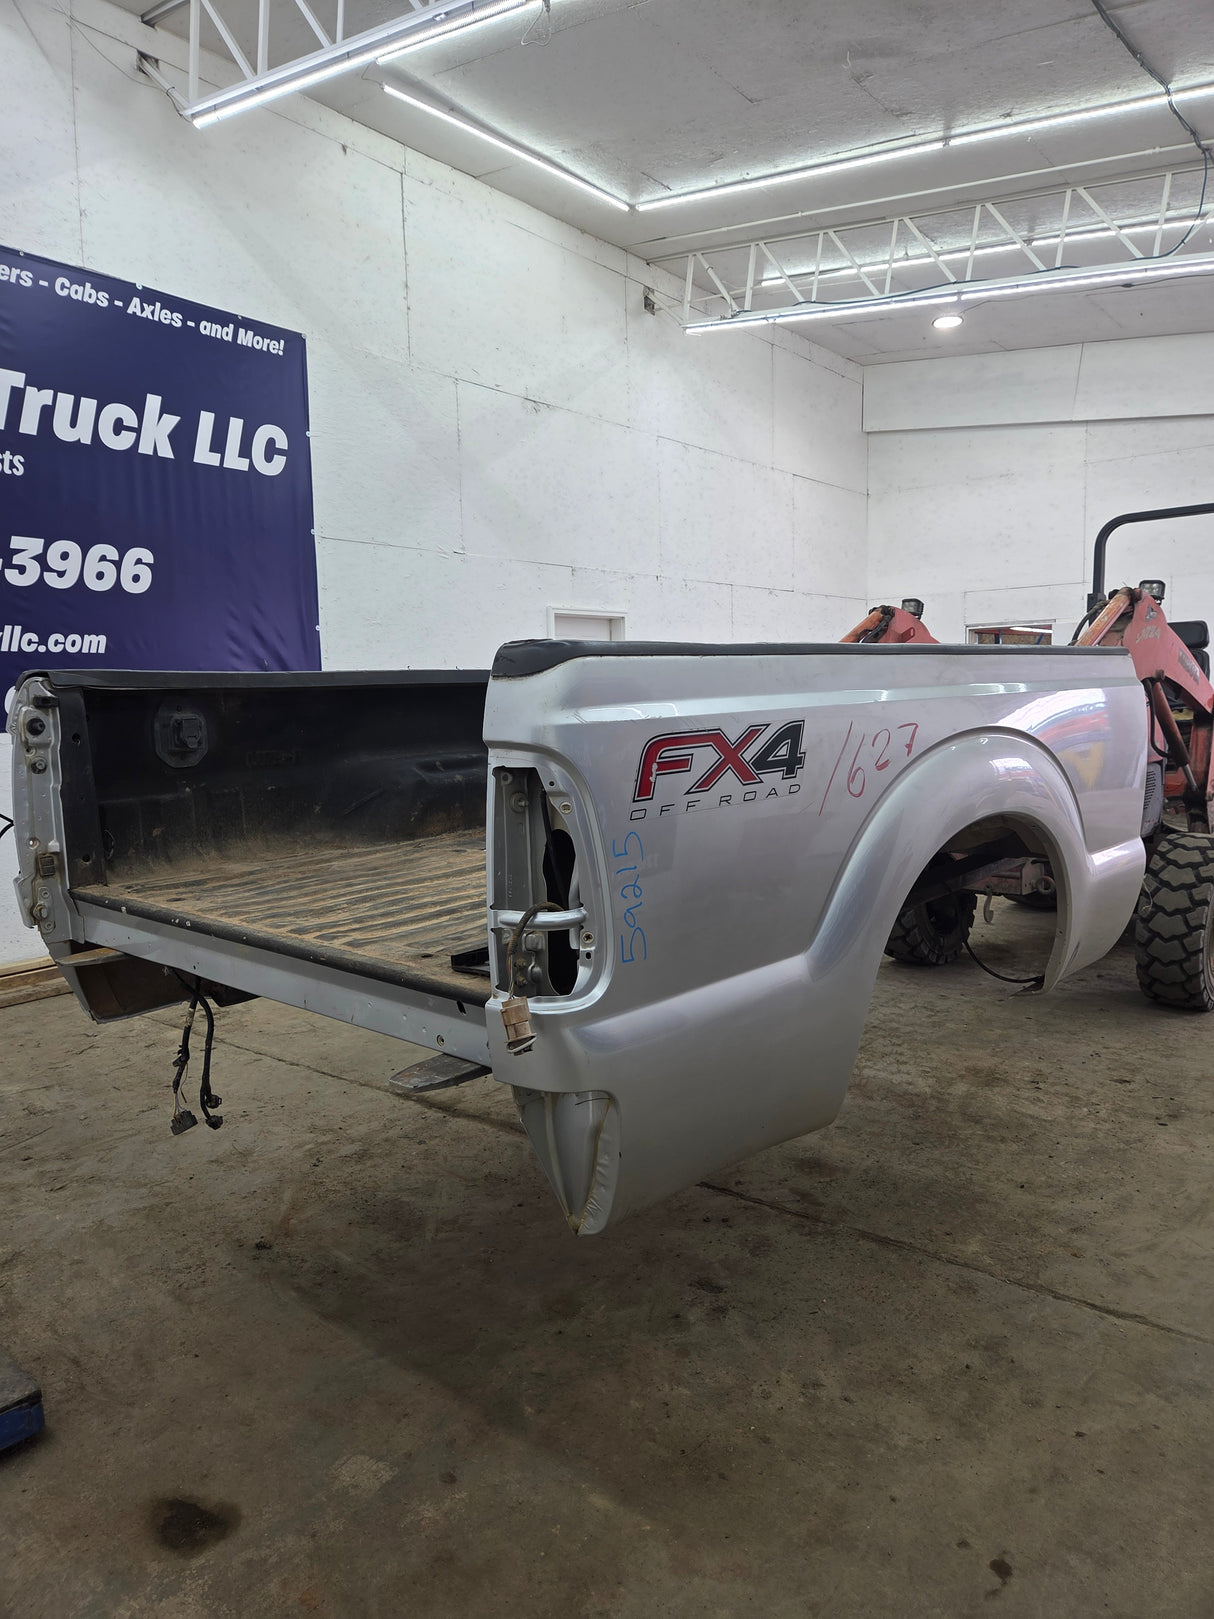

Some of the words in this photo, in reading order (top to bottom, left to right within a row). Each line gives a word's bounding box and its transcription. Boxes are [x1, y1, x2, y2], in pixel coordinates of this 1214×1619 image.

[54, 276, 110, 308] Cabs
[126, 297, 184, 328] Axles
[199, 319, 234, 342] and
[236, 328, 286, 356] More!
[0, 367, 182, 459] Truck
[193, 410, 289, 476] LLC
[0, 535, 155, 595] 3966
[0, 625, 107, 654] llc.com
[632, 719, 807, 804] FX4
[629, 799, 702, 822] OFF
[718, 783, 801, 807] ROAD
